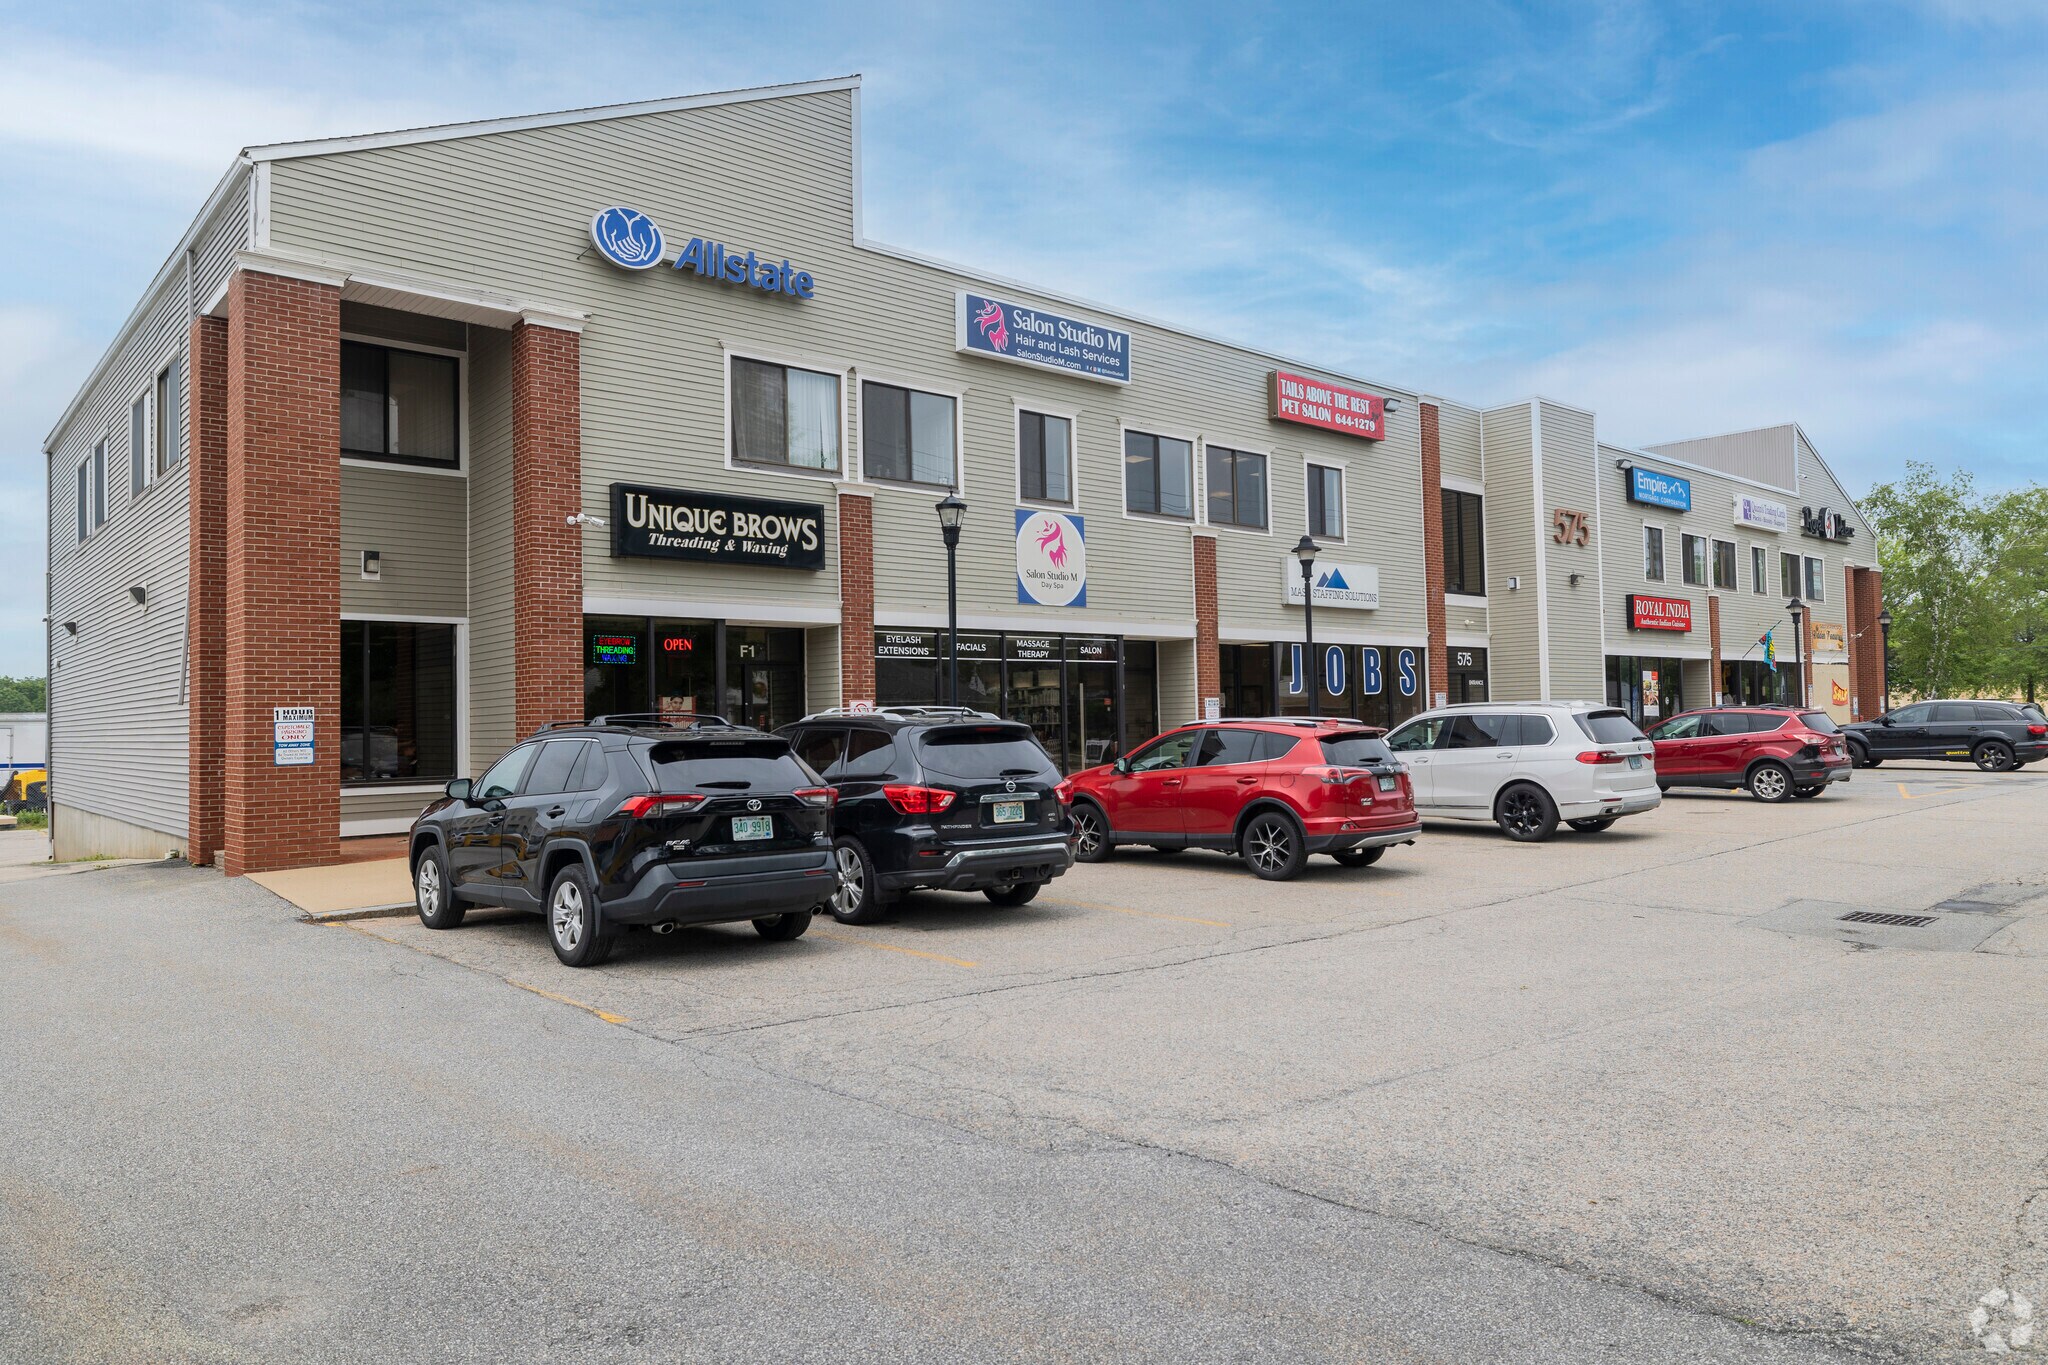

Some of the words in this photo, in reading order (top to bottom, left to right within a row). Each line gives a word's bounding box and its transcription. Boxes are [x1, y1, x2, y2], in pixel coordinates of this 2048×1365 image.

[671, 237, 814, 299] Allstate
[1013, 310, 1055, 337] Salon
[1058, 321, 1104, 348] Studio
[1107, 332, 1122, 353] M
[1015, 333, 1035, 348] Hair
[1038, 338, 1056, 353] and
[1058, 345, 1080, 358] Lash
[1082, 349, 1120, 366] Services
[1016, 349, 1081, 370] SalonStudioM.com
[1281, 379, 1304, 400] TAILS
[1306, 385, 1332, 406] ABOVE
[1333, 392, 1349, 410] THE
[1350, 396, 1370, 415] REST
[1281, 398, 1300, 415] PET
[1302, 402, 1332, 422] SALON
[1335, 412, 1375, 432] 644-1279
[1637, 472, 1667, 495] Empire
[625, 492, 727, 536] UNIQUE
[733, 511, 818, 551] BROWS
[1553, 507, 1590, 547] 575
[648, 532, 720, 553] Threading
[724, 538, 736, 551] &
[742, 540, 788, 558] Waxing
[1026, 569, 1046, 579] Salon
[1047, 570, 1069, 581] Studio
[1070, 572, 1078, 581] M
[1041, 581, 1052, 589] Day
[1290, 587, 1309, 597] MAS
[1313, 589, 1343, 600] STAFFING
[1345, 591, 1377, 602] SOLUTIONS
[1636, 599, 1664, 617] ROYAL
[1666, 602, 1689, 618] INDIA
[599, 637, 631, 645] EYEBROW
[663, 638, 693, 651] OPEN
[886, 634, 921, 645] EYELASH
[1016, 639, 1050, 648] MASSAGE
[596, 645, 634, 655] THREADING
[740, 644, 755, 658] F1
[878, 645, 929, 656] EXTENSIONS
[956, 642, 986, 652] FACIALS
[1017, 649, 1049, 659] THERAPY
[1080, 646, 1102, 655] SALON
[602, 654, 627, 662] WAXING
[1457, 651, 1473, 666] 575
[1289, 643, 1417, 697] JOBS
[275, 710, 280, 720] 1
[733, 821, 748, 834] 340
[752, 820, 771, 832] 9918
